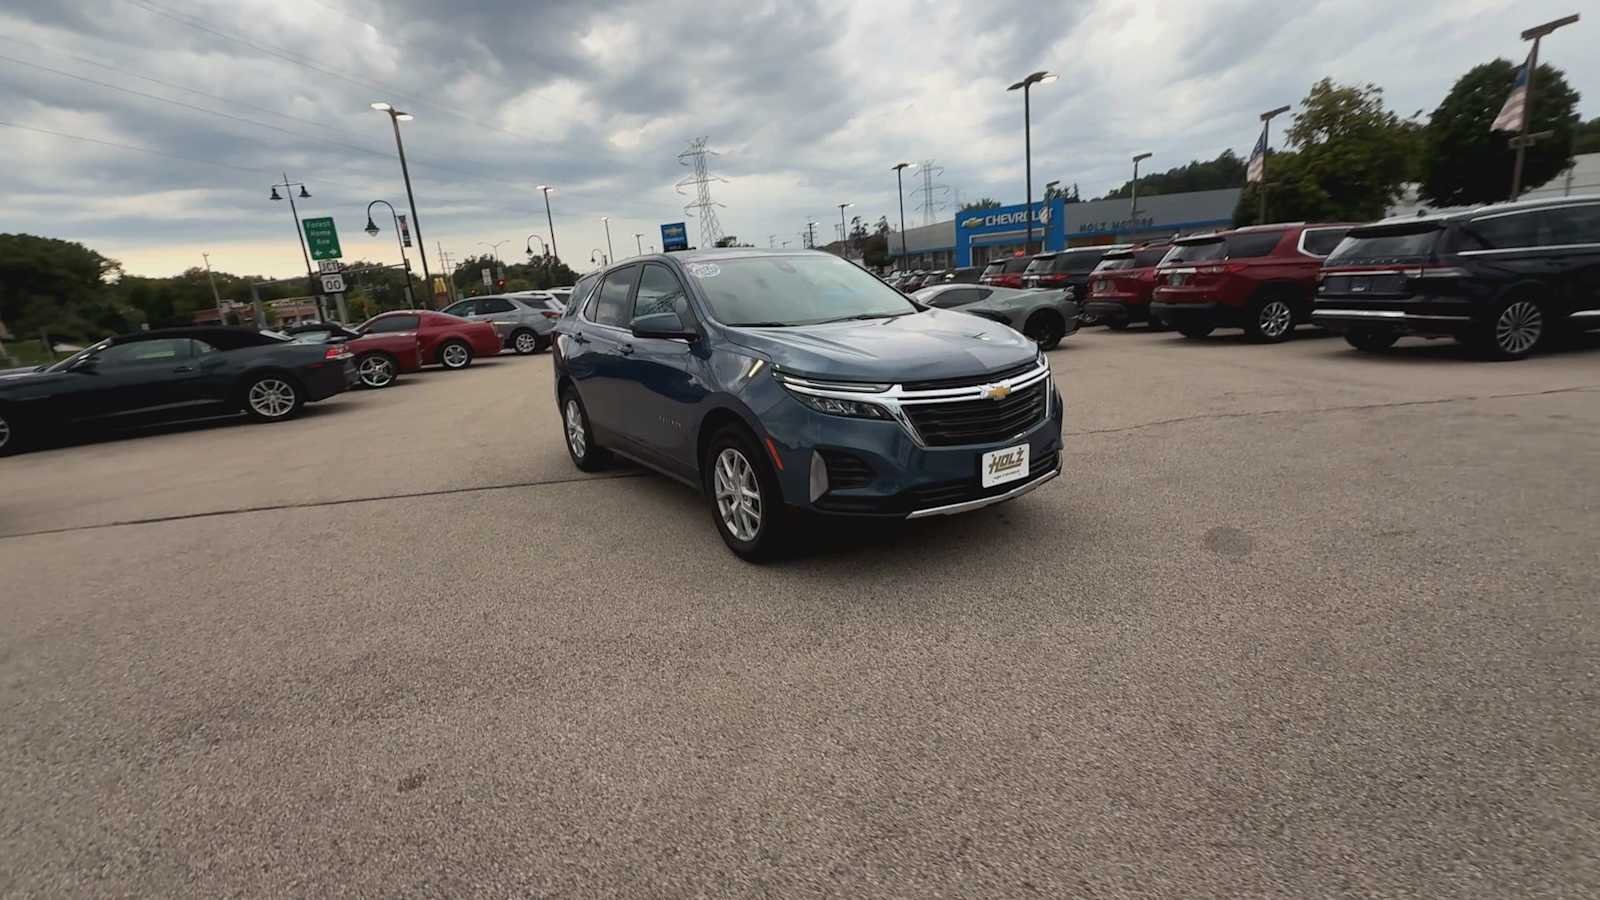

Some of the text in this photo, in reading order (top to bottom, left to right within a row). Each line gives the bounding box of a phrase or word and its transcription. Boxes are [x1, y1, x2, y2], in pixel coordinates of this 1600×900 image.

[985, 207, 1053, 226] CHEVRLT
[322, 262, 337, 272] JCT
[989, 448, 1025, 474] HOLZ
